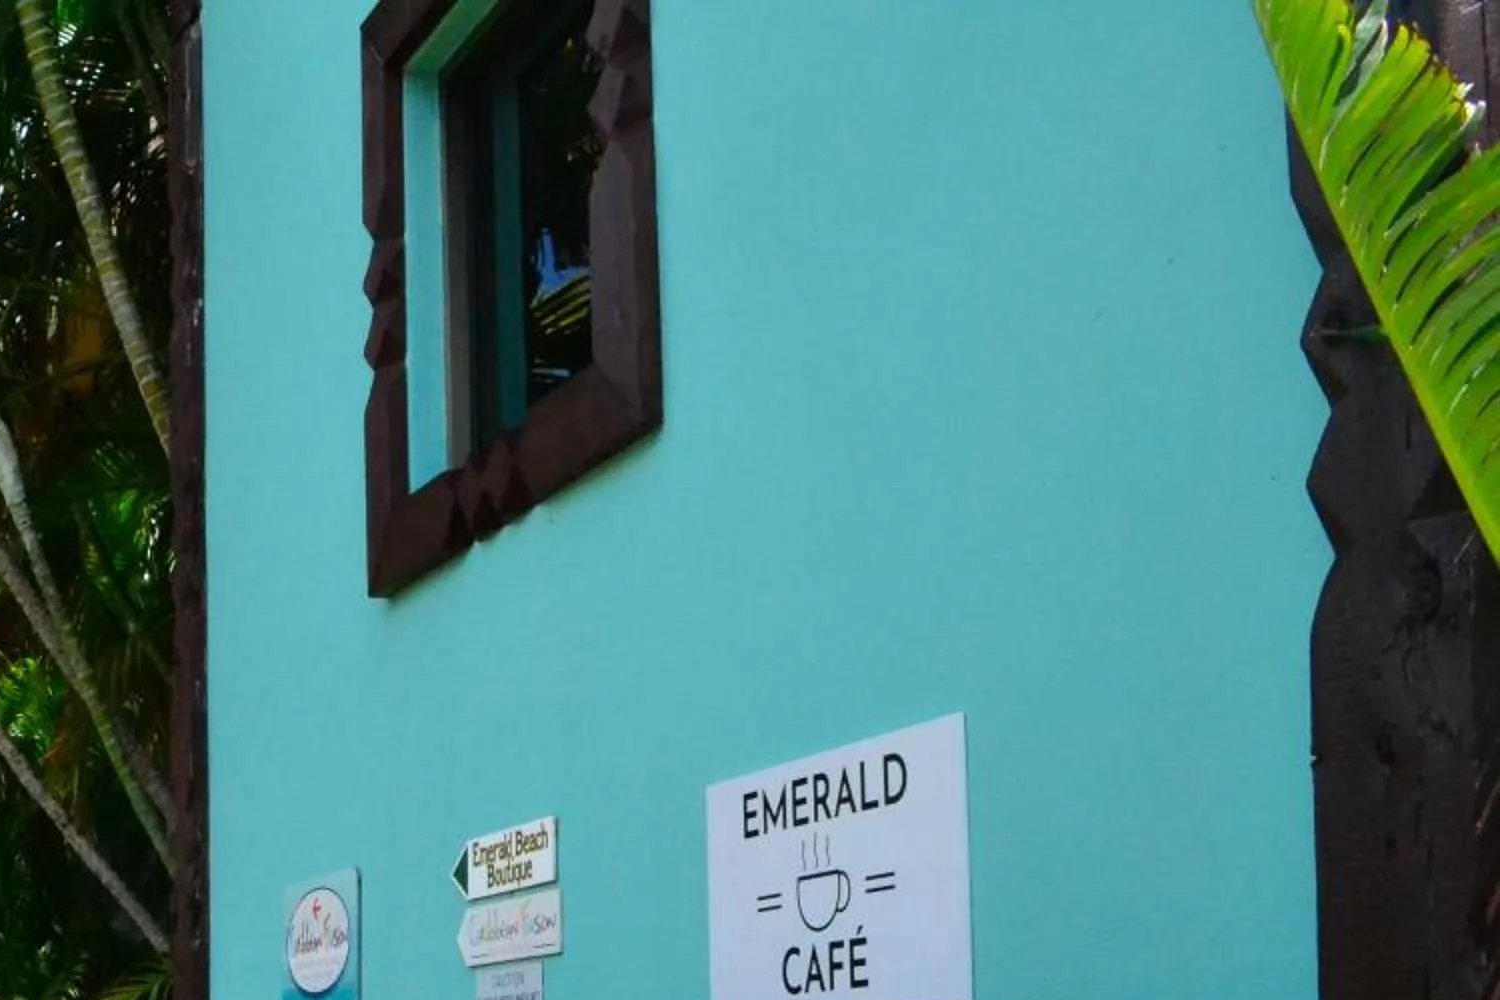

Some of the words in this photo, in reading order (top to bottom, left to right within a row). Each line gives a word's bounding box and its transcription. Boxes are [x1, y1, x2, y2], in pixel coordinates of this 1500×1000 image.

[742, 752, 908, 840] EMERALD
[472, 831, 513, 868] Emerald
[515, 821, 549, 856] Beach
[486, 859, 533, 889] Boutique
[782, 924, 870, 996] CAFÉ
